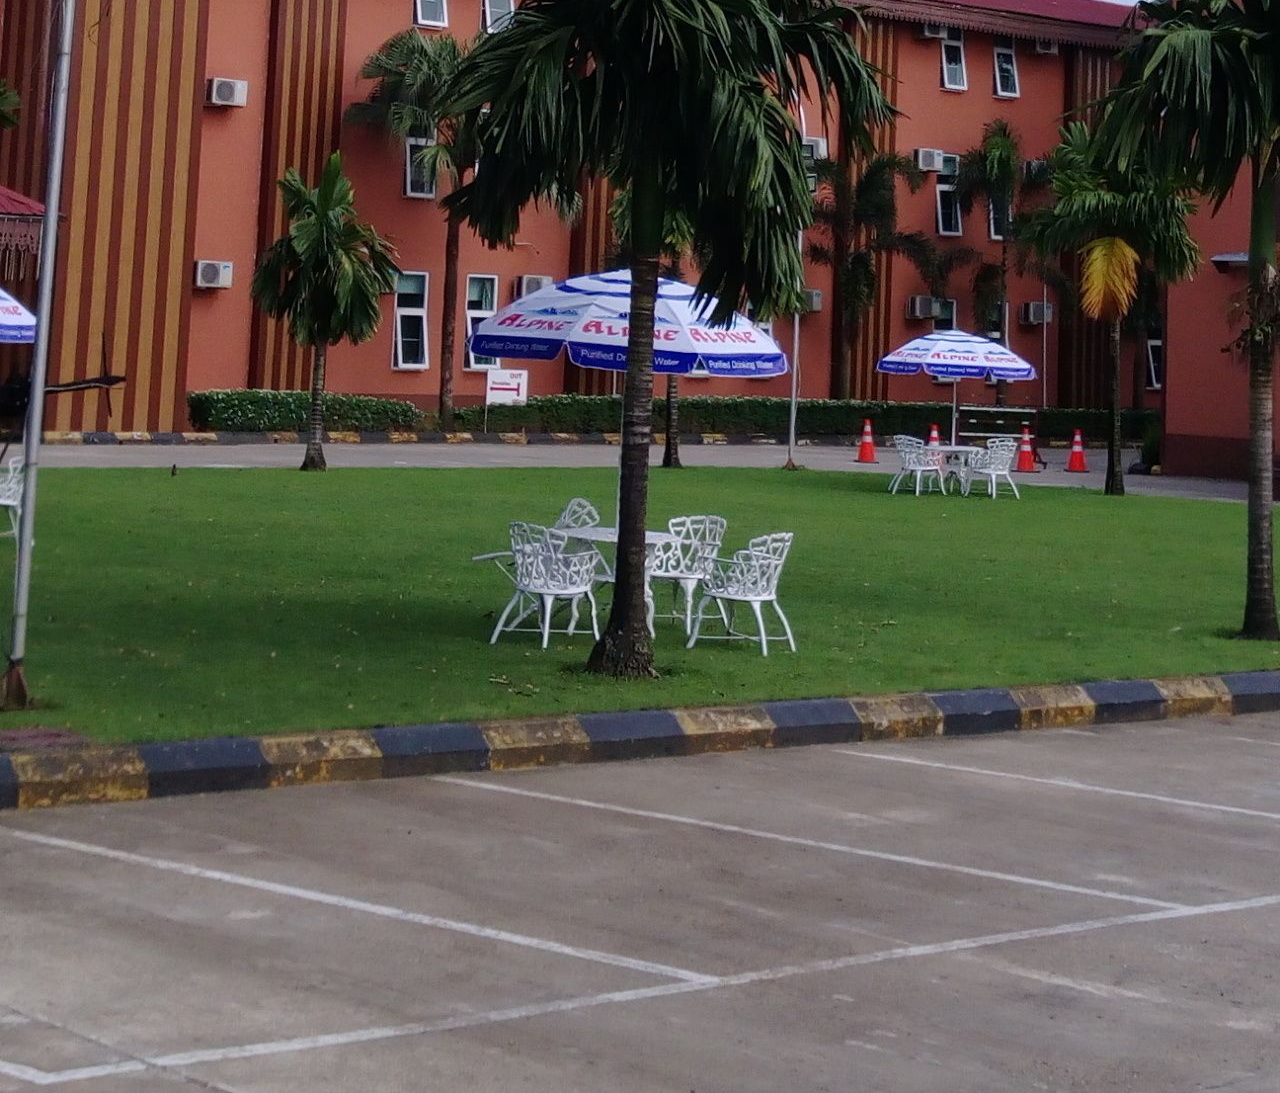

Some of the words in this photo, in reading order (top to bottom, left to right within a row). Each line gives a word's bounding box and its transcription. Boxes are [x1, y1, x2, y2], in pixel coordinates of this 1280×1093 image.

[497, 313, 573, 332] ALPINE
[582, 320, 680, 342] ALNE
[689, 327, 757, 344] ALPINE
[931, 352, 979, 362] ALPINE
